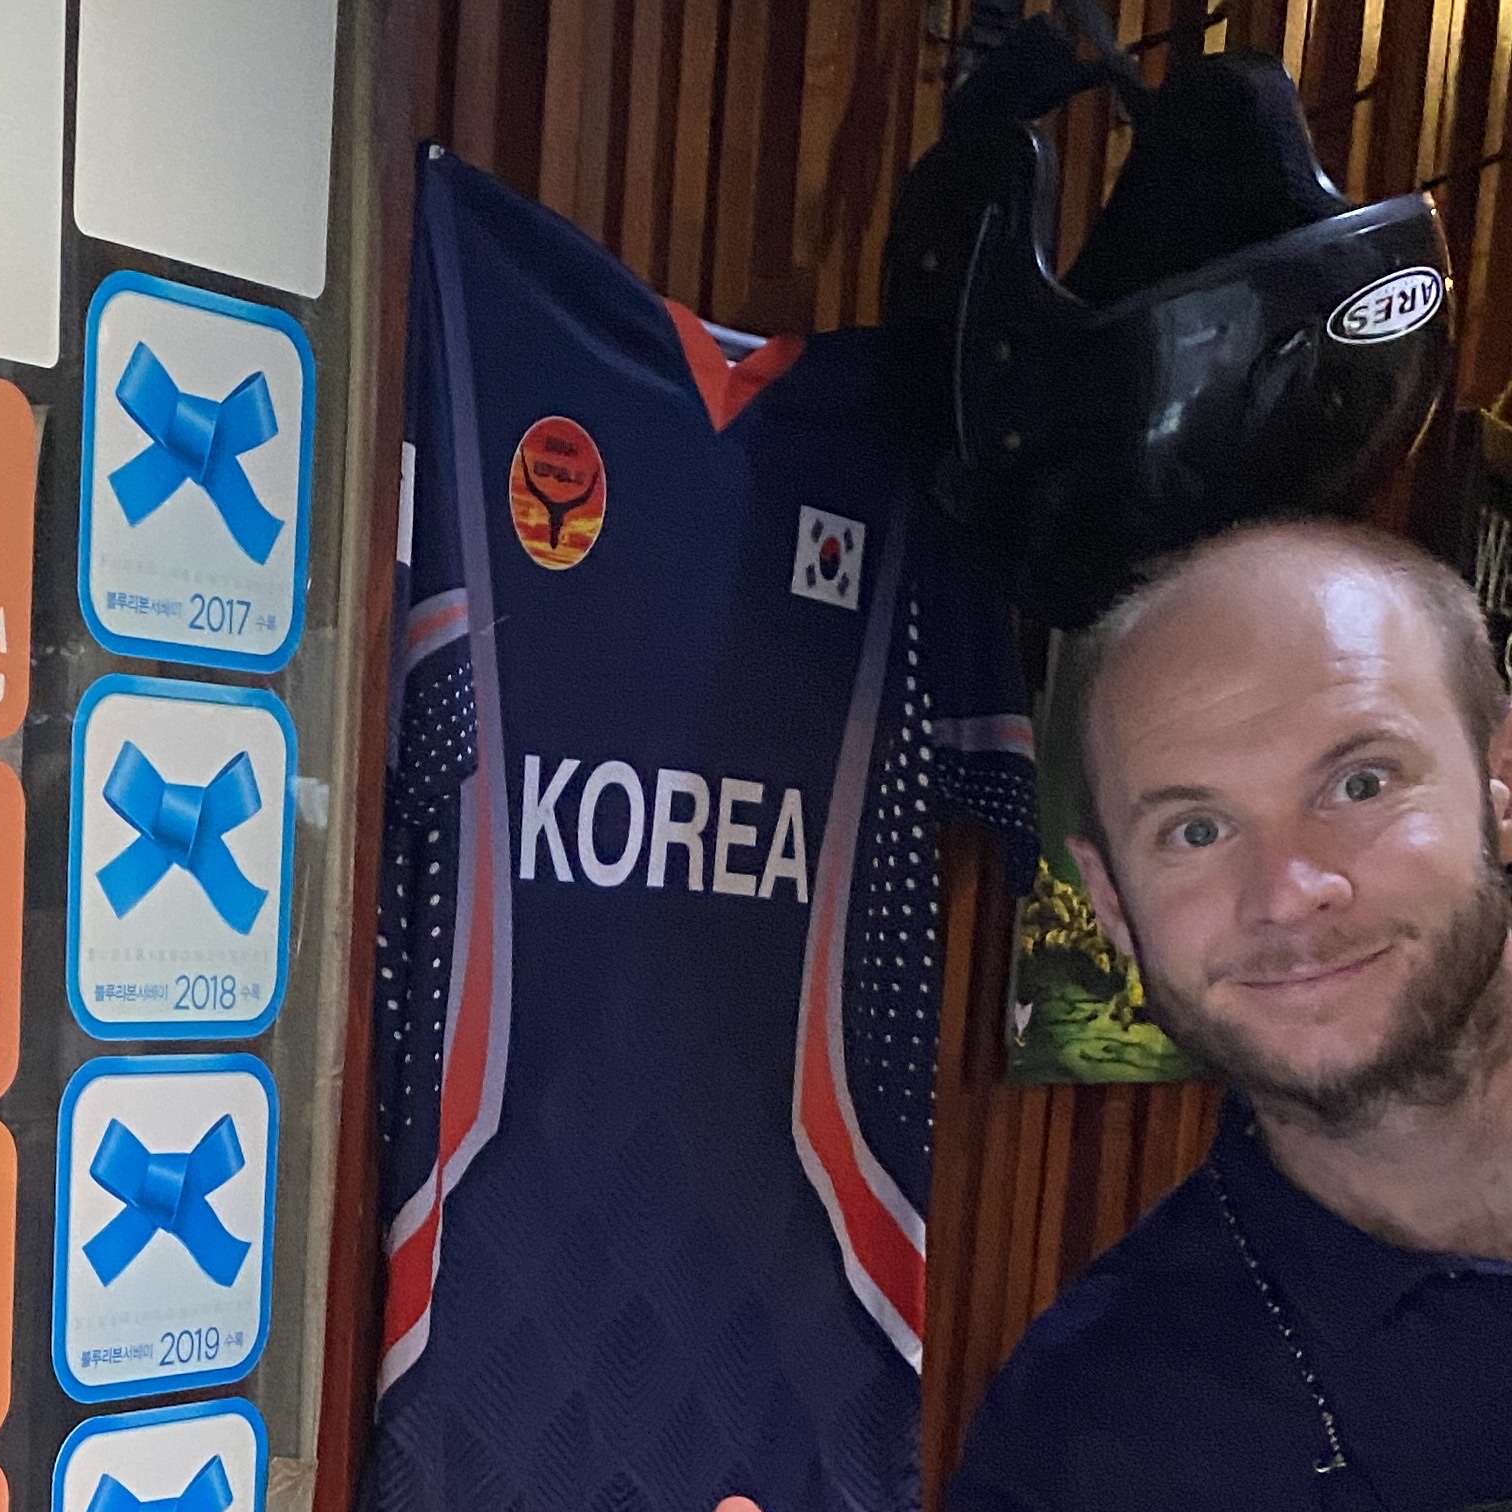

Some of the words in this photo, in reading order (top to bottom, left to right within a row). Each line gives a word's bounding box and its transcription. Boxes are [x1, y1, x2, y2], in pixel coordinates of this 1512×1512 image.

[1347, 277, 1435, 331] ARES
[189, 593, 251, 635] 2017
[519, 754, 809, 904] KOREA
[173, 975, 236, 1010] 2018
[159, 1326, 220, 1367] 2019
